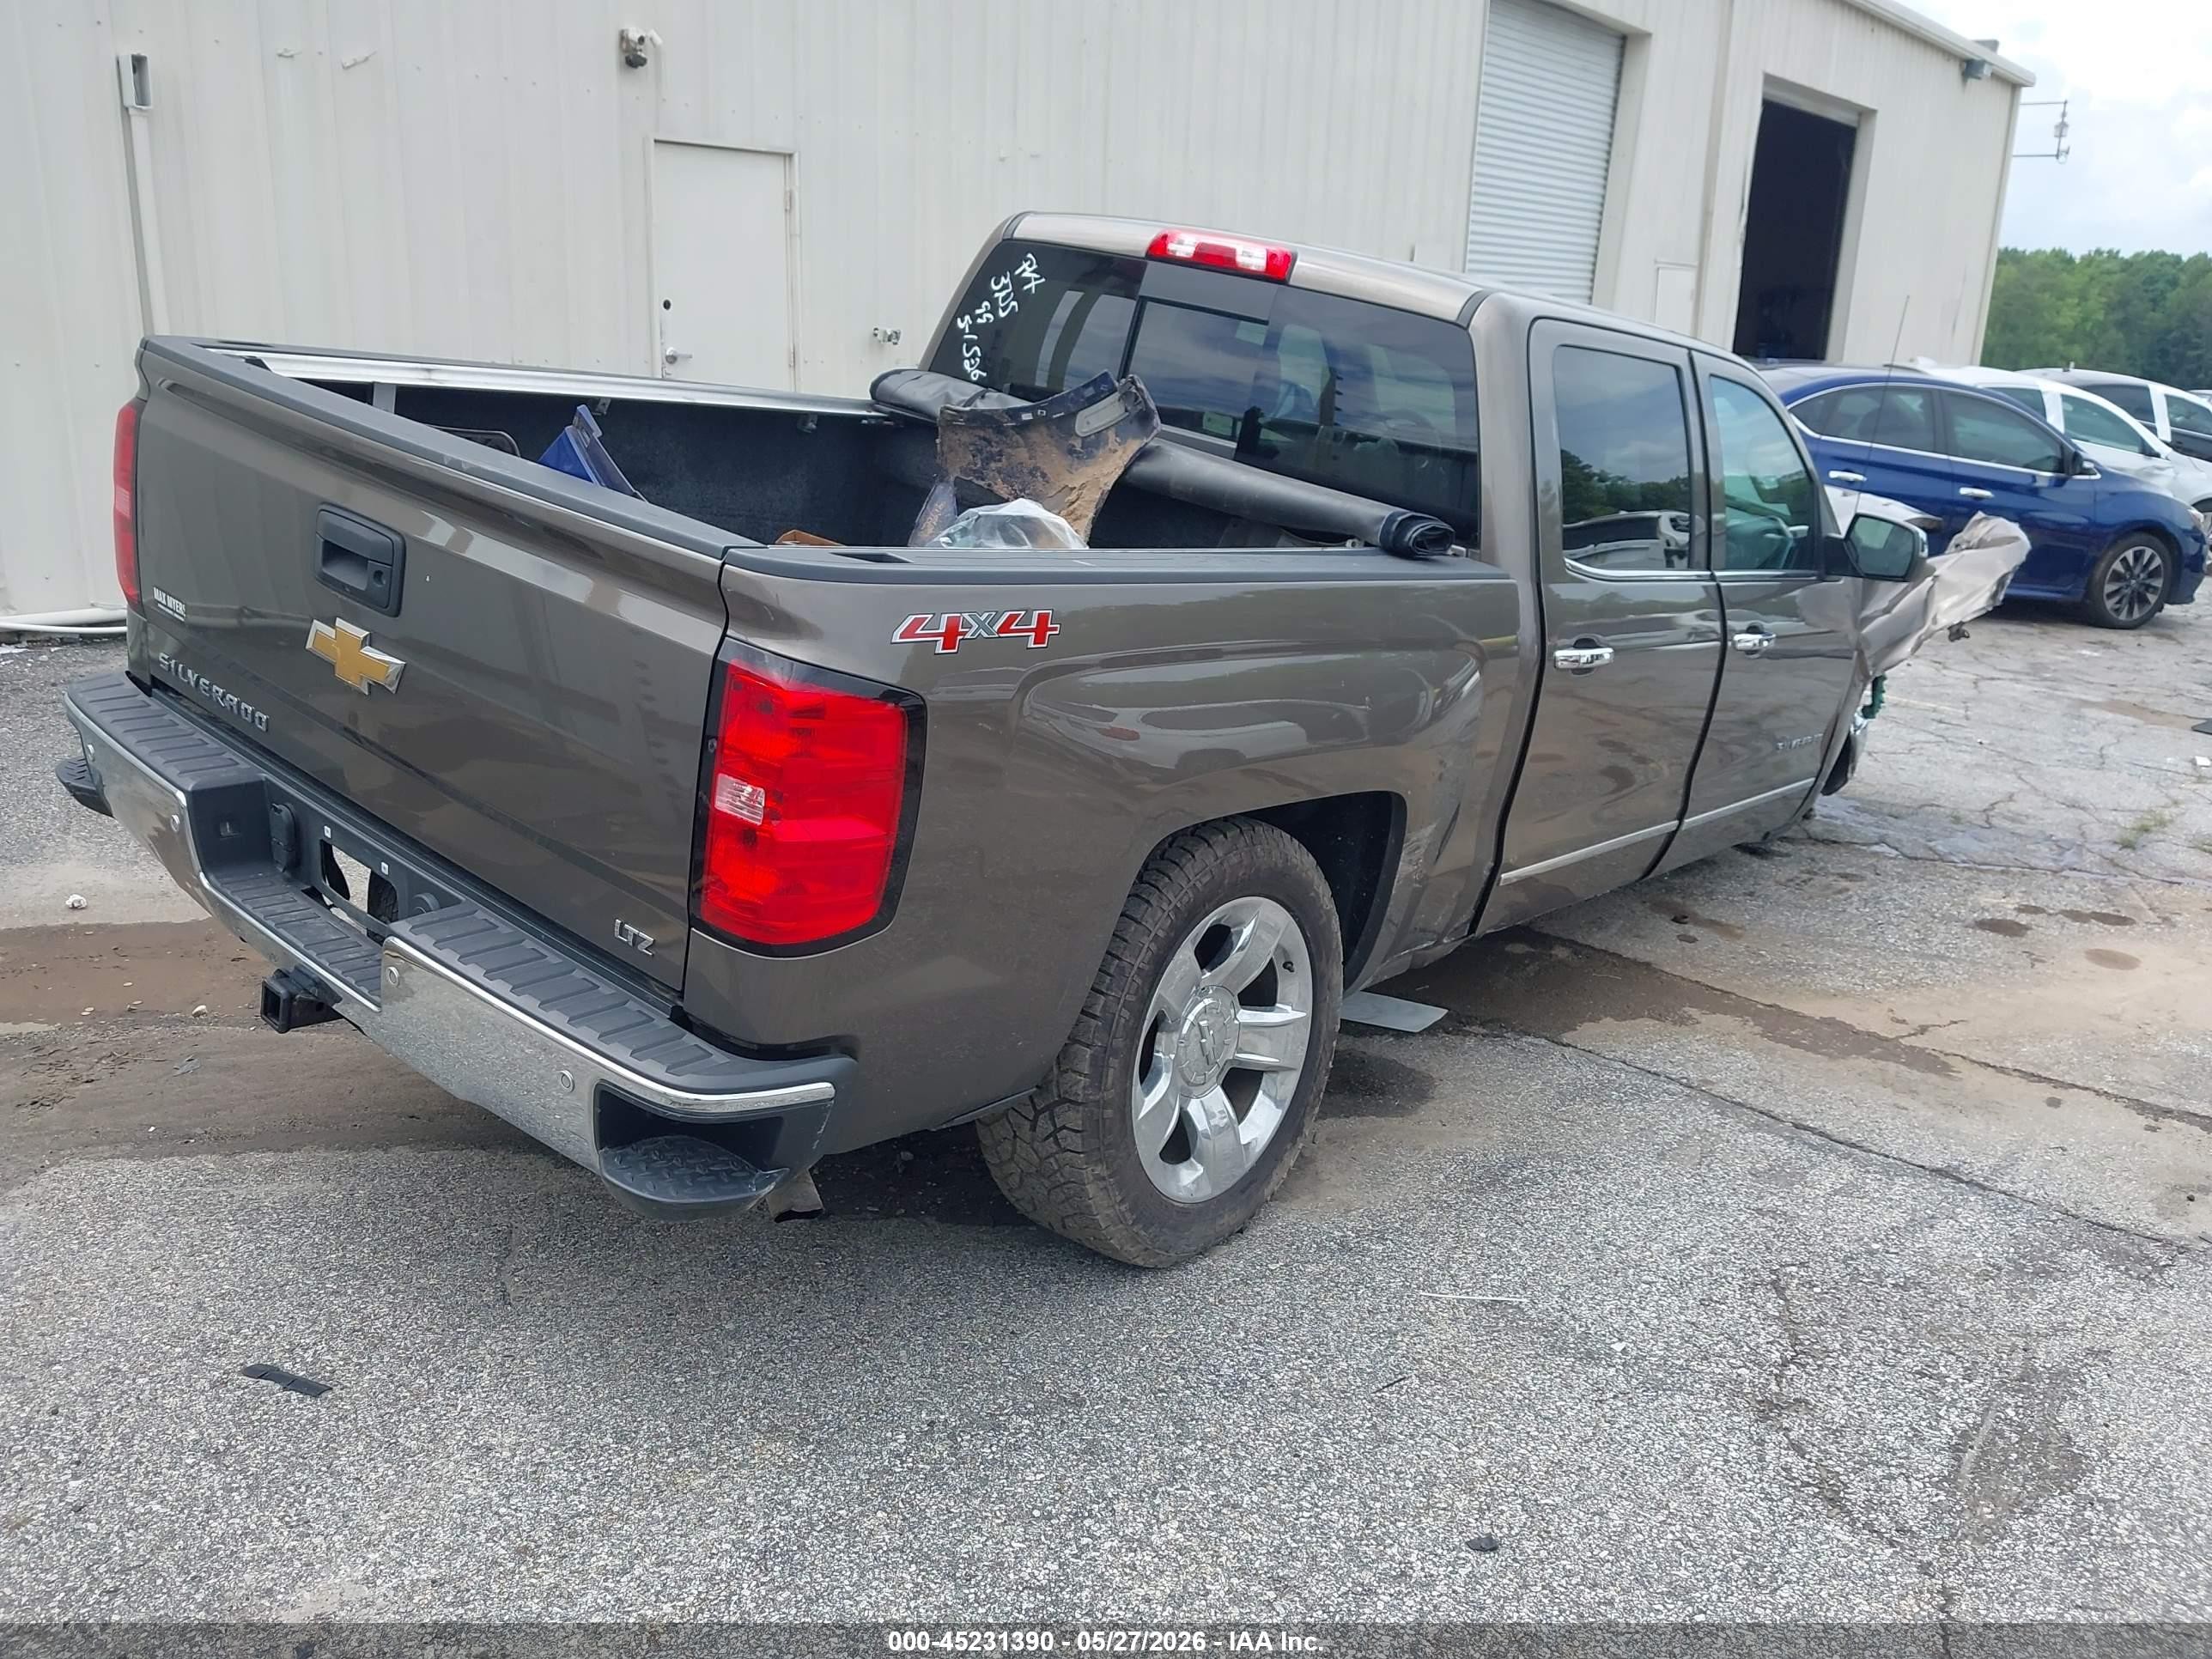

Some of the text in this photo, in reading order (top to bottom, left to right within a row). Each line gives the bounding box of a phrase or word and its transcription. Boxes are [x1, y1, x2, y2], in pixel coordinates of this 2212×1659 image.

[167, 594, 186, 617] MYERS
[158, 652, 269, 732] SILVERADO
[614, 919, 655, 956] LTZ
